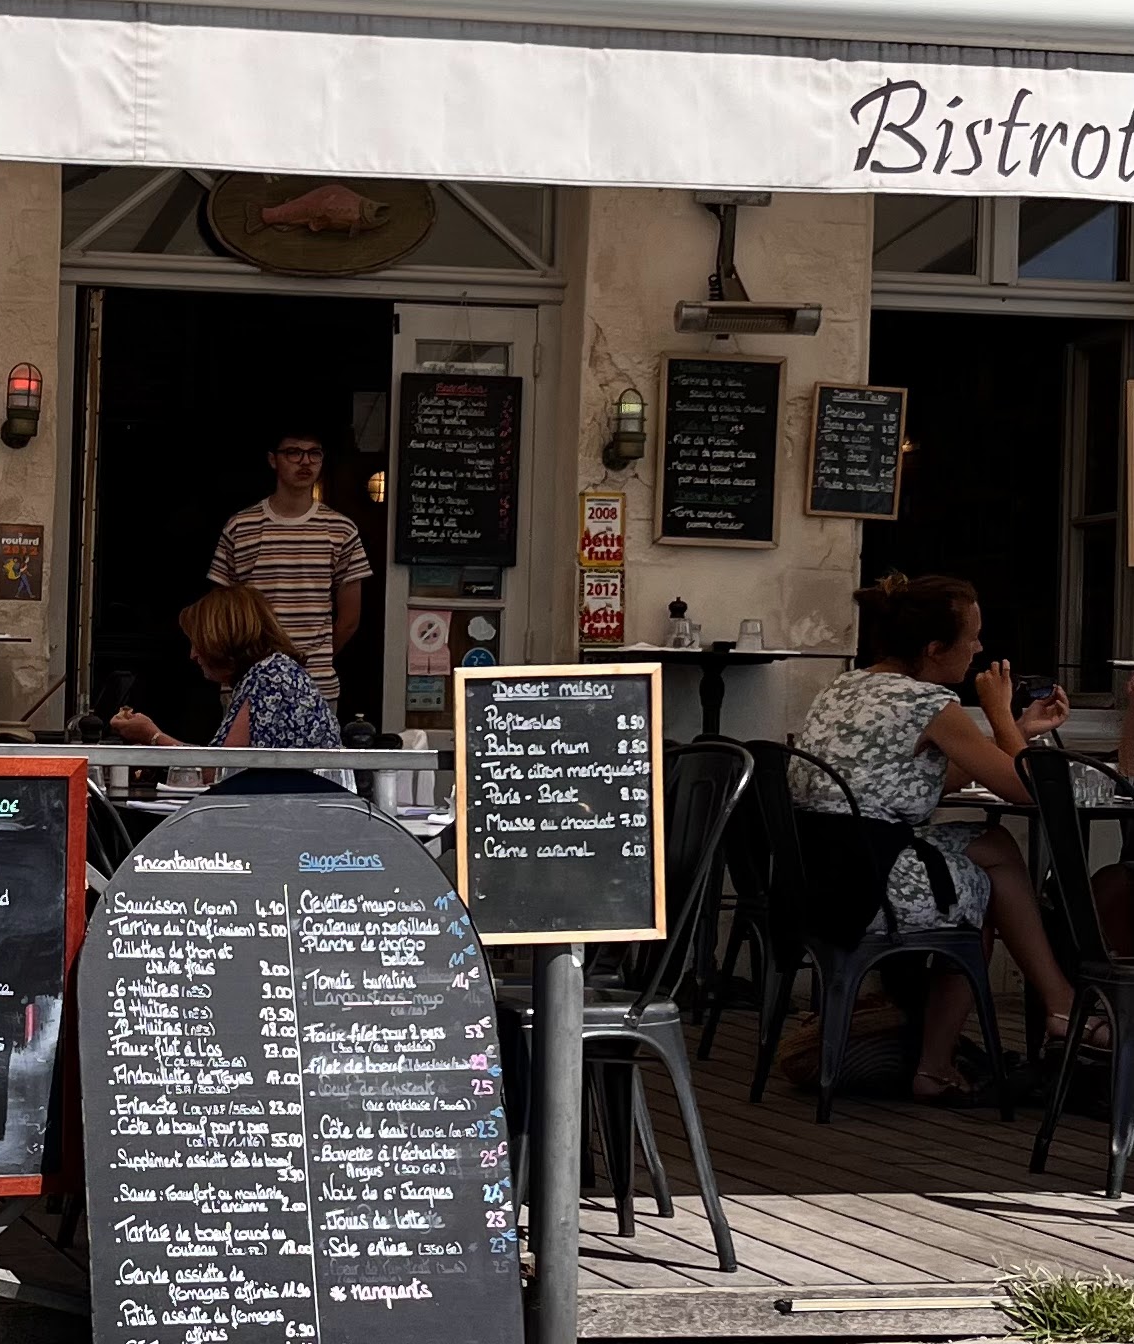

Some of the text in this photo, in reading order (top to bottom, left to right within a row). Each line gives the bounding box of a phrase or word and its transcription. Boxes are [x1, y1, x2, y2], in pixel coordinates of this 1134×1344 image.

[850, 78, 1134, 182] Bistrot
[588, 507, 617, 520] 2008
[2, 537, 39, 545] routard
[582, 533, 624, 550] petit
[588, 547, 622, 560] futé
[586, 583, 618, 596] 2012
[580, 609, 624, 627] petit
[588, 623, 624, 639] futé
[492, 681, 549, 697] Dessert
[484, 705, 645, 735] Profiteroles 8.50
[484, 733, 648, 756] Baba au rhum 8.50
[481, 761, 524, 779] Tarte
[528, 763, 563, 779] citron
[482, 782, 520, 804] Paris
[538, 784, 578, 803] Brest
[486, 813, 535, 831] Mousse
[540, 819, 558, 830] au
[620, 813, 647, 827] 7.00
[484, 837, 646, 858] Crème caramel 6.00
[299, 849, 382, 873] Suggestions
[114, 892, 187, 914] Saucisson
[113, 938, 165, 958] Rillettes
[169, 940, 184, 958] de
[322, 1145, 373, 1162] Bavette
[323, 1173, 357, 1201] Noix
[400, 1181, 454, 1208] Jacques
[169, 1283, 229, 1306] fromages
[230, 1305, 284, 1329] fromages
